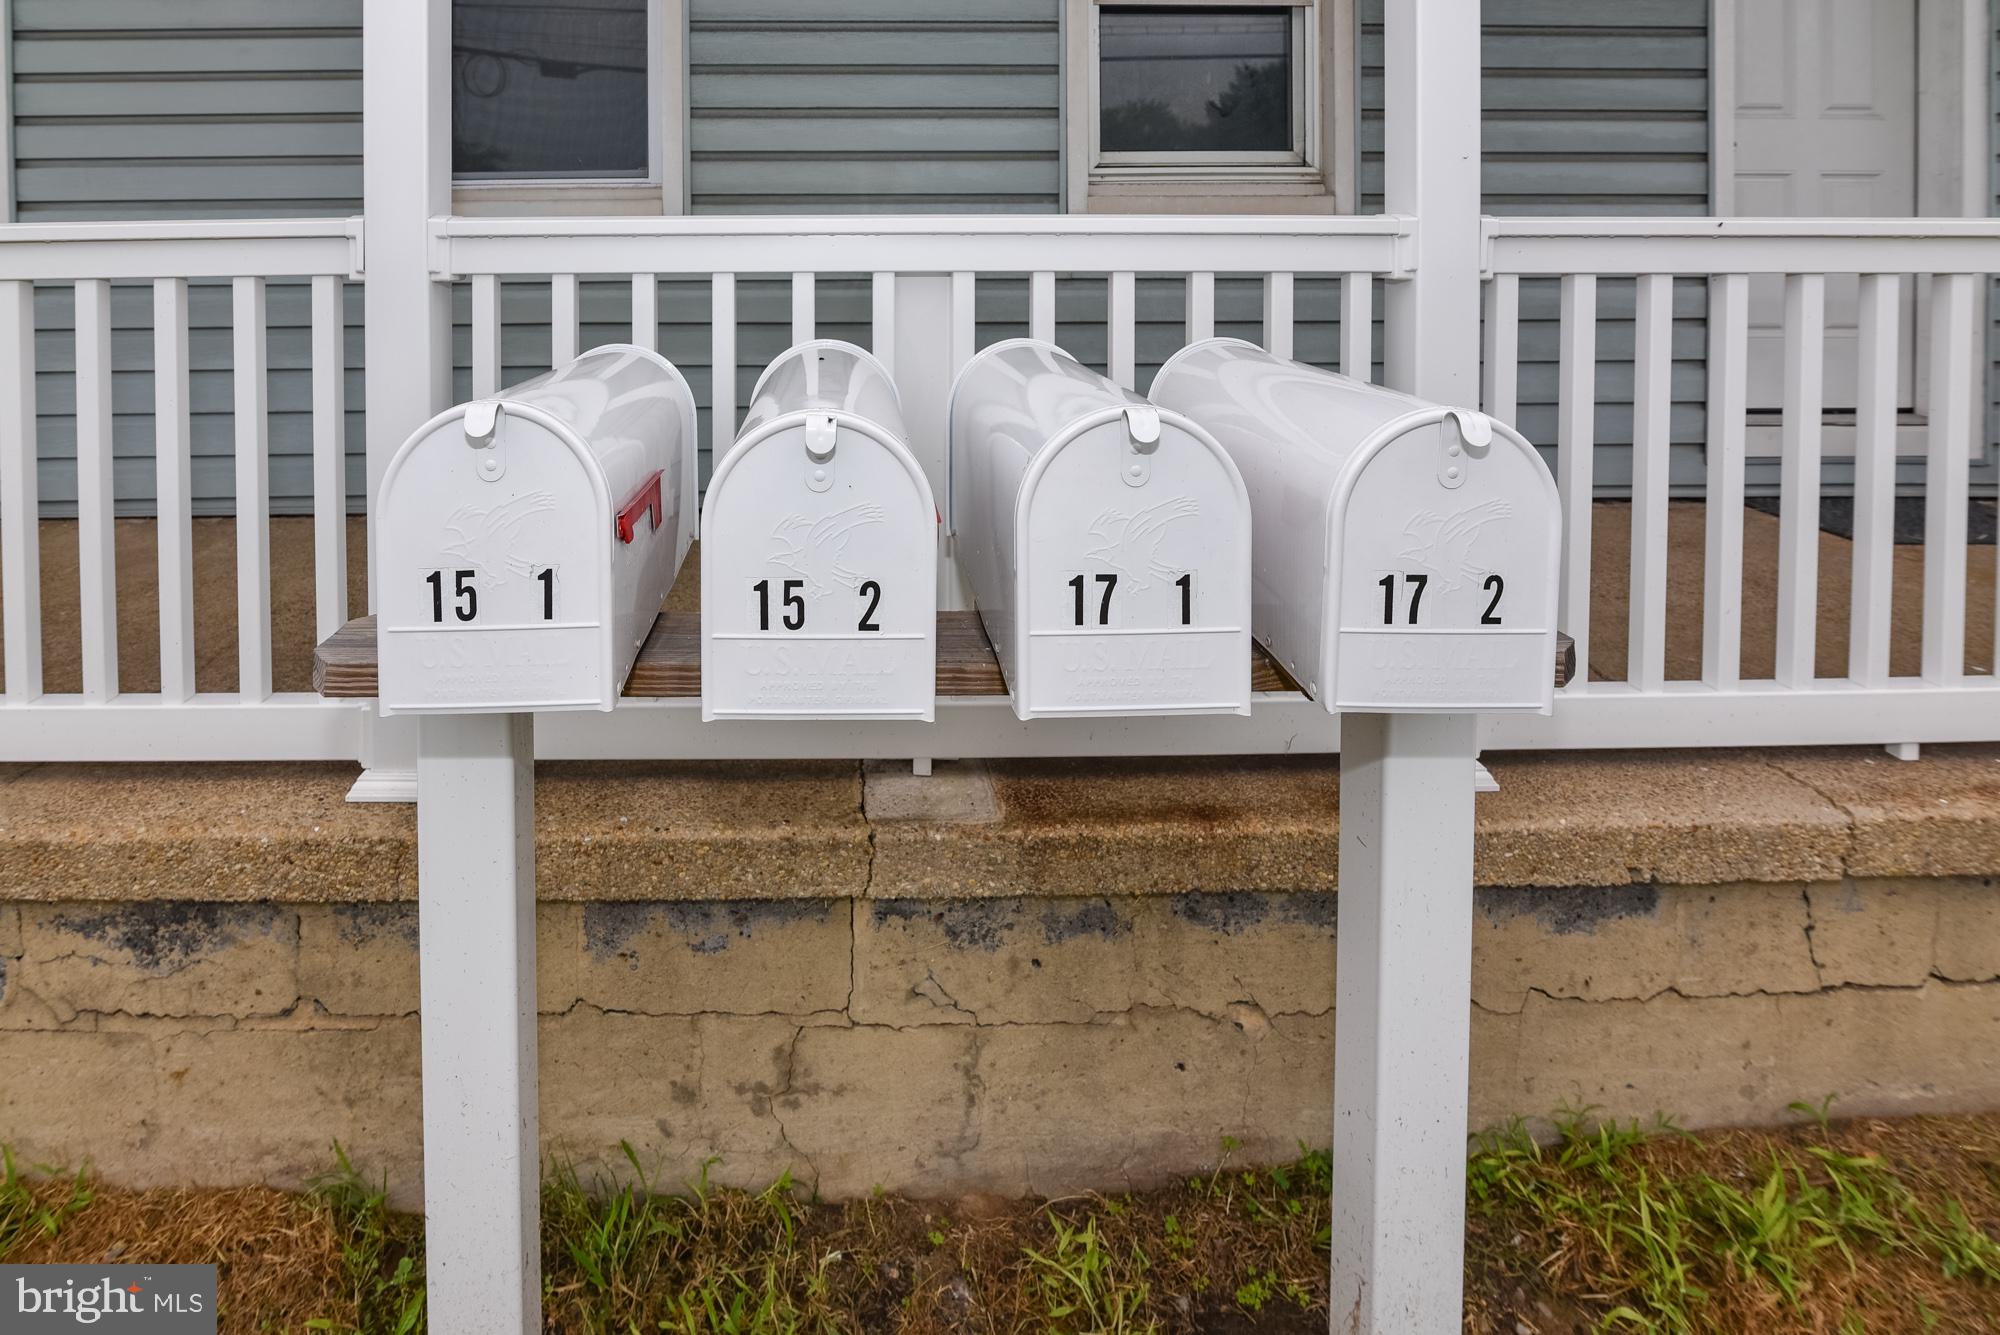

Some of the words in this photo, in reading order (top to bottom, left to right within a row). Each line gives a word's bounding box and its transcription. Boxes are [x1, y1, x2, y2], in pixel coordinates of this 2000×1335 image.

[426, 569, 478, 622] 15
[537, 568, 553, 620] 1
[753, 579, 805, 631] 15
[858, 580, 881, 632] 2
[1068, 573, 1118, 626] 17
[1175, 573, 1191, 625] 1
[1378, 574, 1428, 625] 17
[1480, 574, 1504, 625] 2
